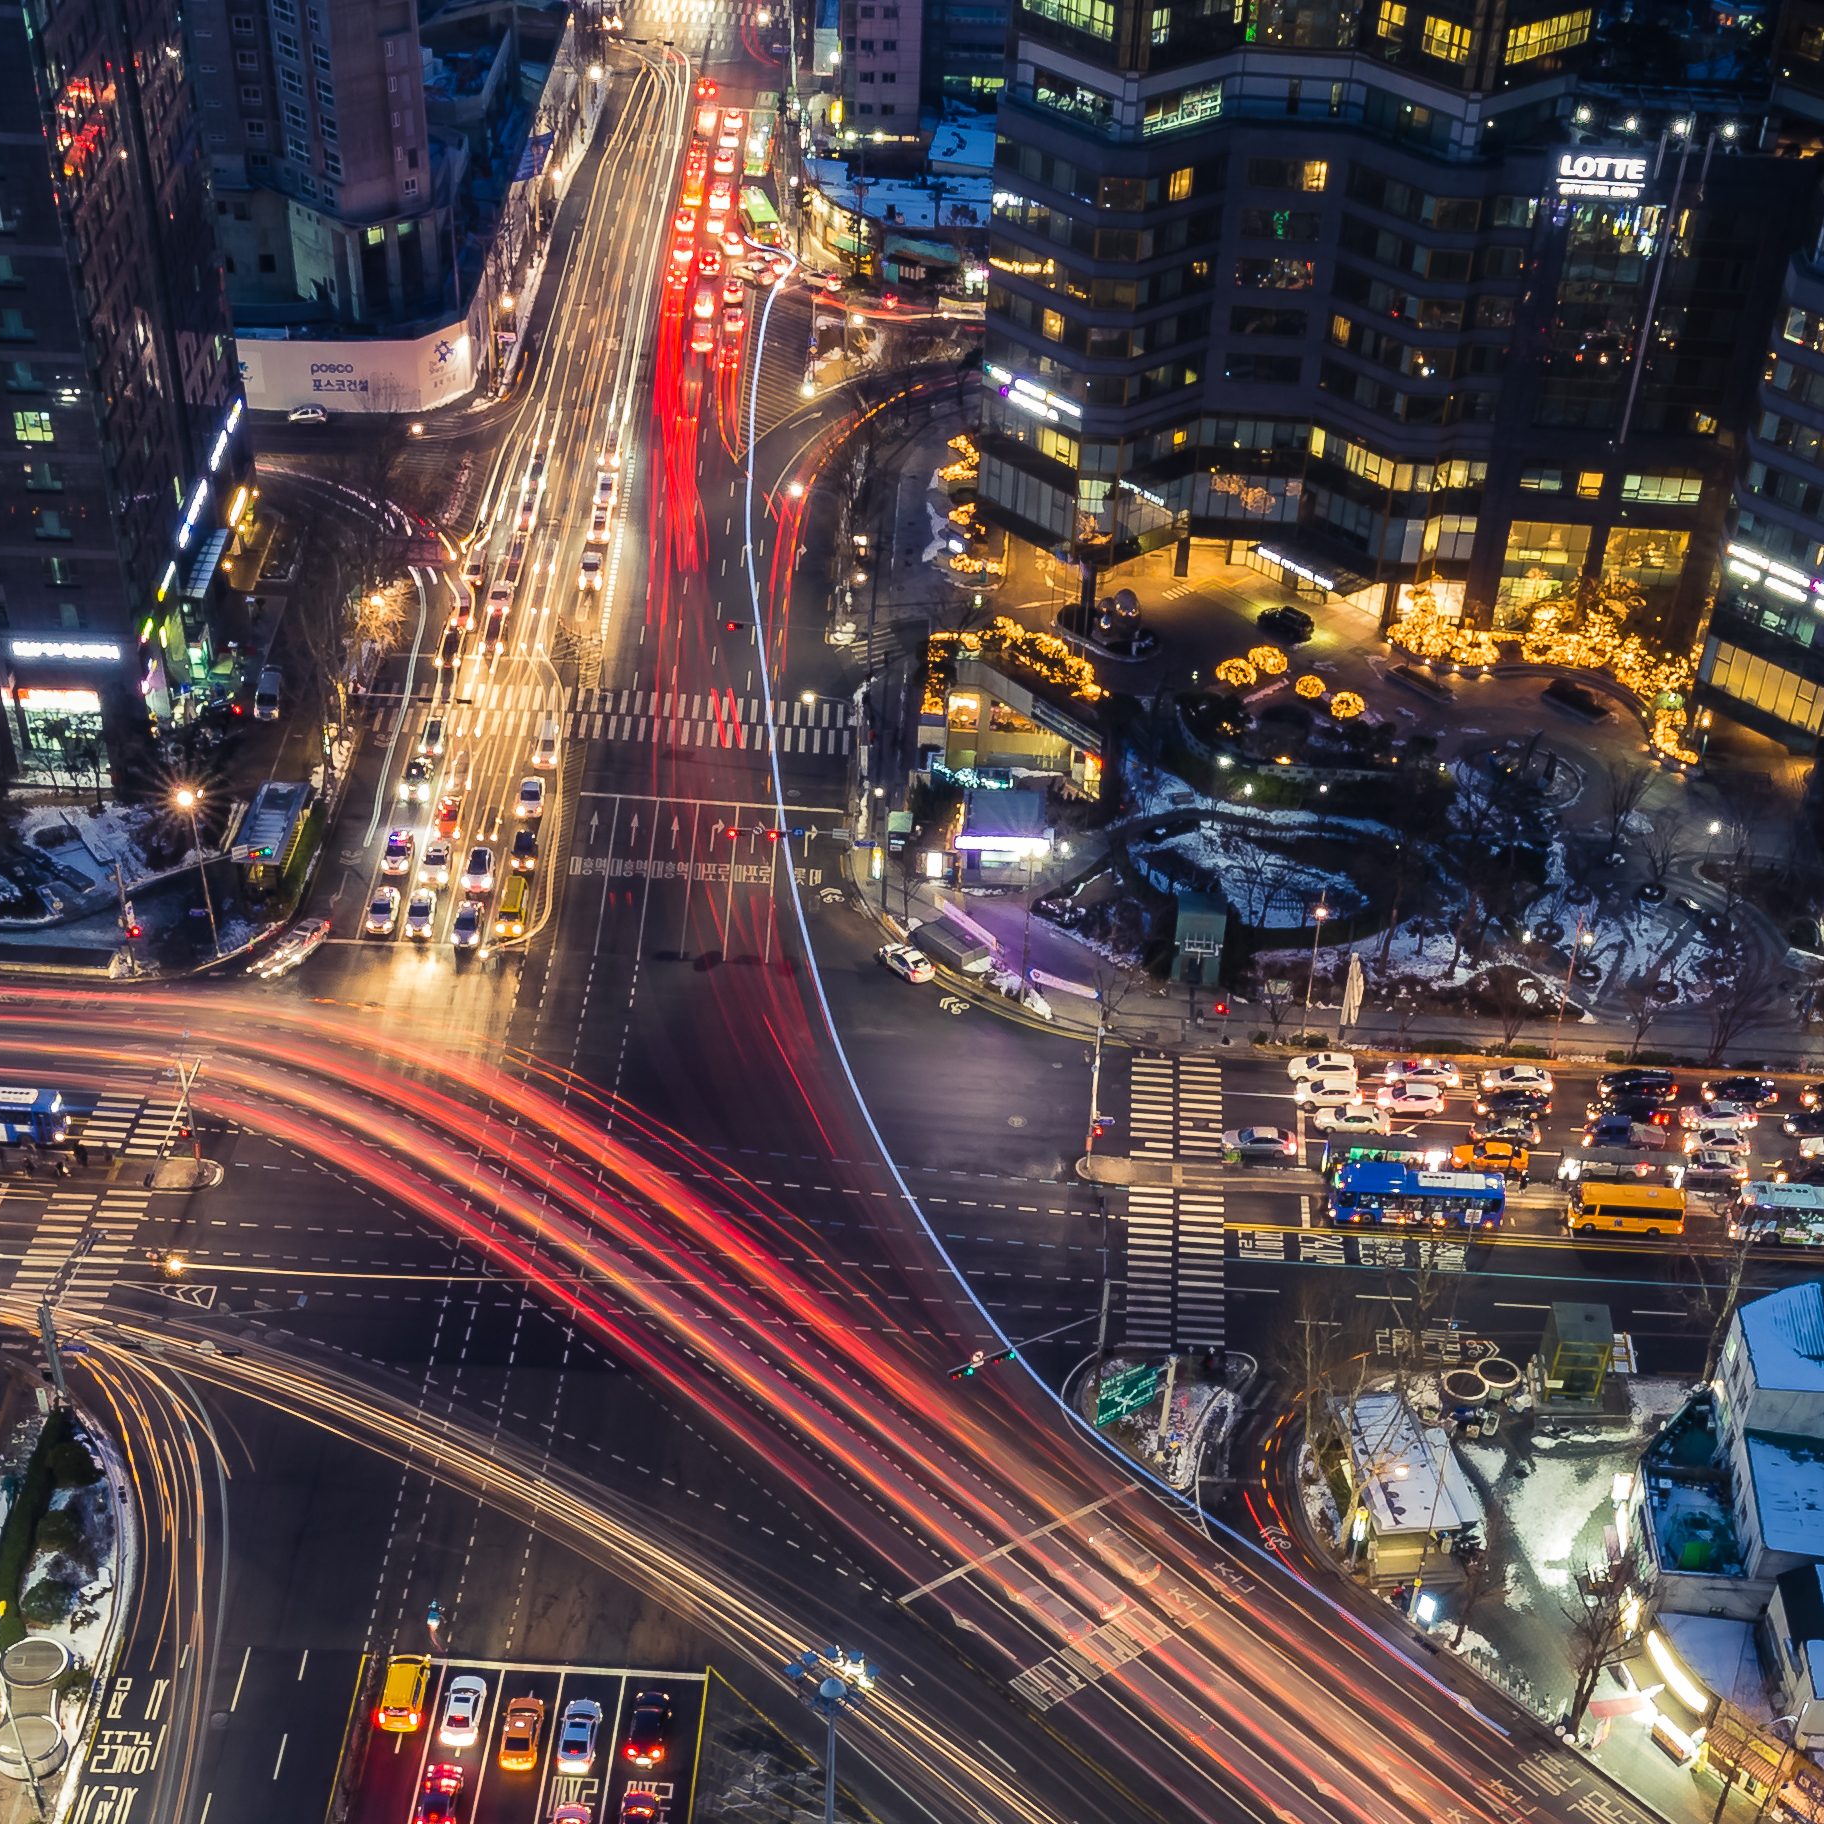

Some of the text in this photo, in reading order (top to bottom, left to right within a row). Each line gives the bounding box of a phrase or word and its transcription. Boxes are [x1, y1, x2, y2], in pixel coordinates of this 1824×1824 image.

[1560, 155, 1647, 180] LOTTE
[311, 363, 354, 376] posco
[312, 378, 369, 393] 포스코건설
[569, 856, 607, 876] 대흥역
[610, 858, 648, 878] 대흥역
[651, 860, 689, 880] 대흥역
[734, 864, 772, 885] 마포로
